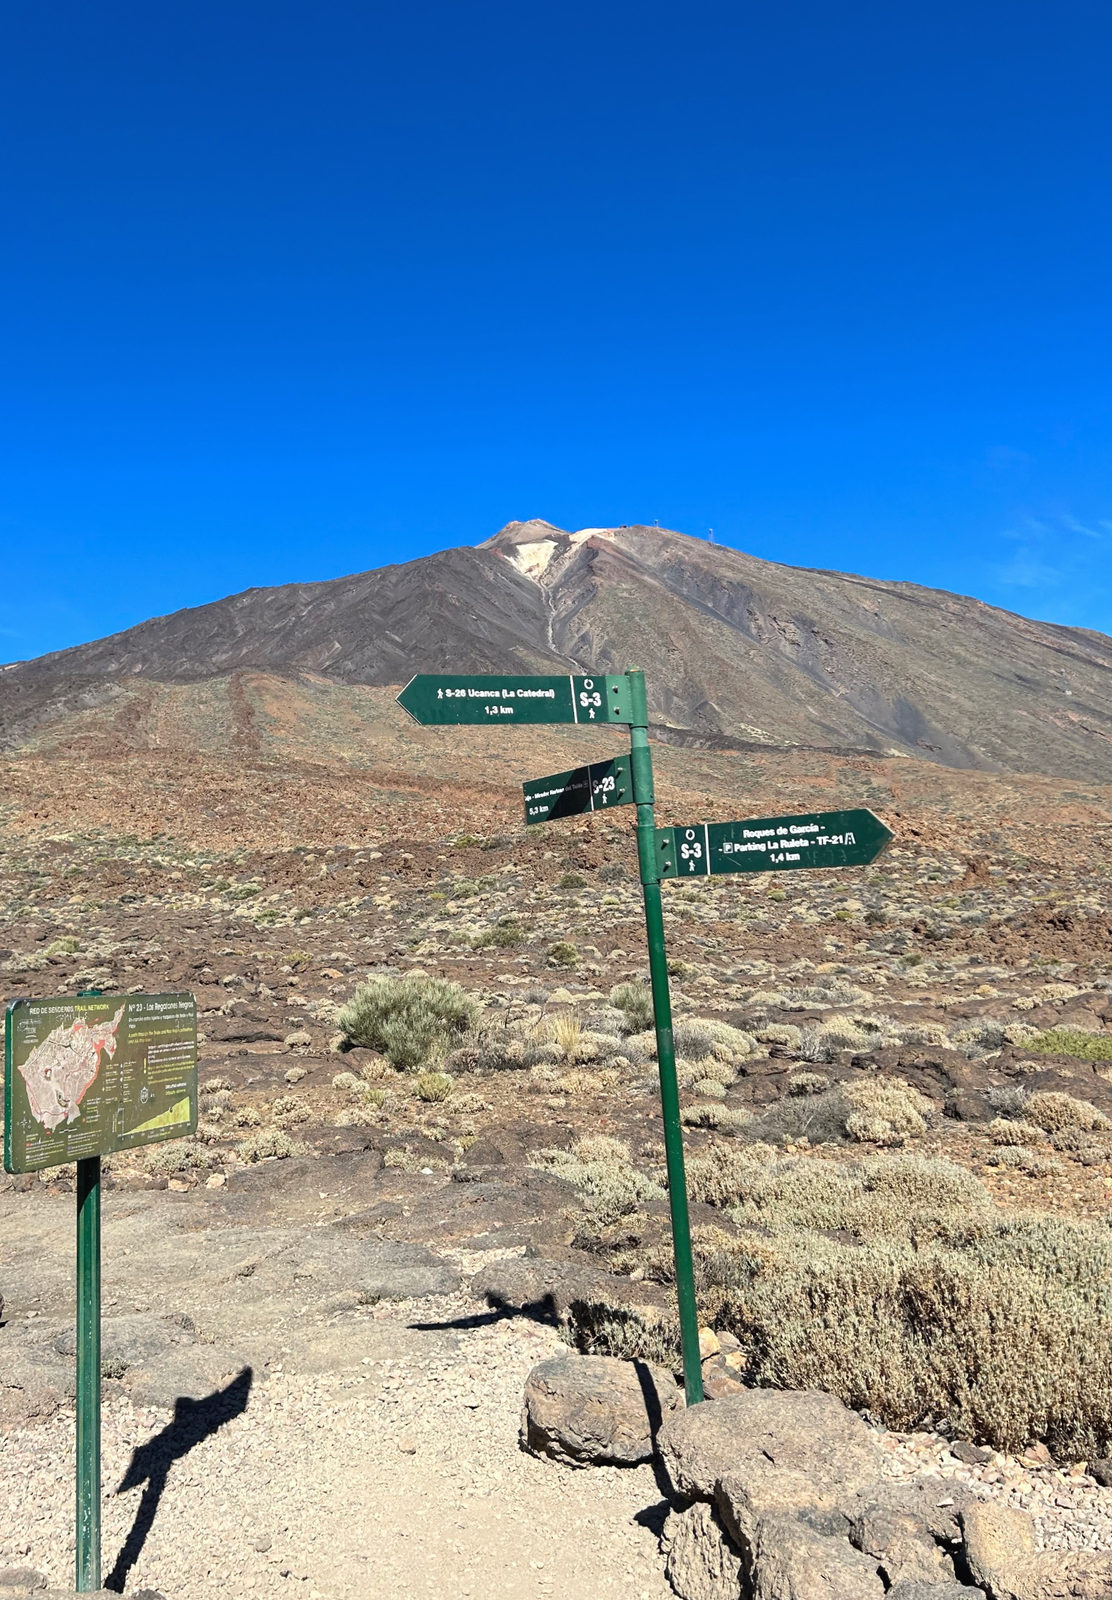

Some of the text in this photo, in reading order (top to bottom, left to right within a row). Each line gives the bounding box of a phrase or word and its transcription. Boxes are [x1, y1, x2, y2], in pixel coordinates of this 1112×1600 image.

[445, 688, 555, 699] S-26 Ucanca (La Catedral)
[580, 692, 601, 707] S-3
[485, 706, 514, 715] 1,3 km
[592, 776, 615, 794] S-23
[529, 806, 539, 815] 5,3
[743, 828, 775, 838] Roques
[776, 826, 788, 835] de
[789, 823, 819, 834] García
[734, 842, 766, 852] Parking
[767, 841, 779, 850] La
[780, 838, 809, 849] Ruleta
[816, 834, 843, 846] TF-21
[681, 842, 702, 859] S-3
[770, 852, 800, 863] 1,4 km
[29, 1007, 40, 1015] RED
[88, 1003, 109, 1011] NETWORK
[136, 1003, 143, 1011] 23
